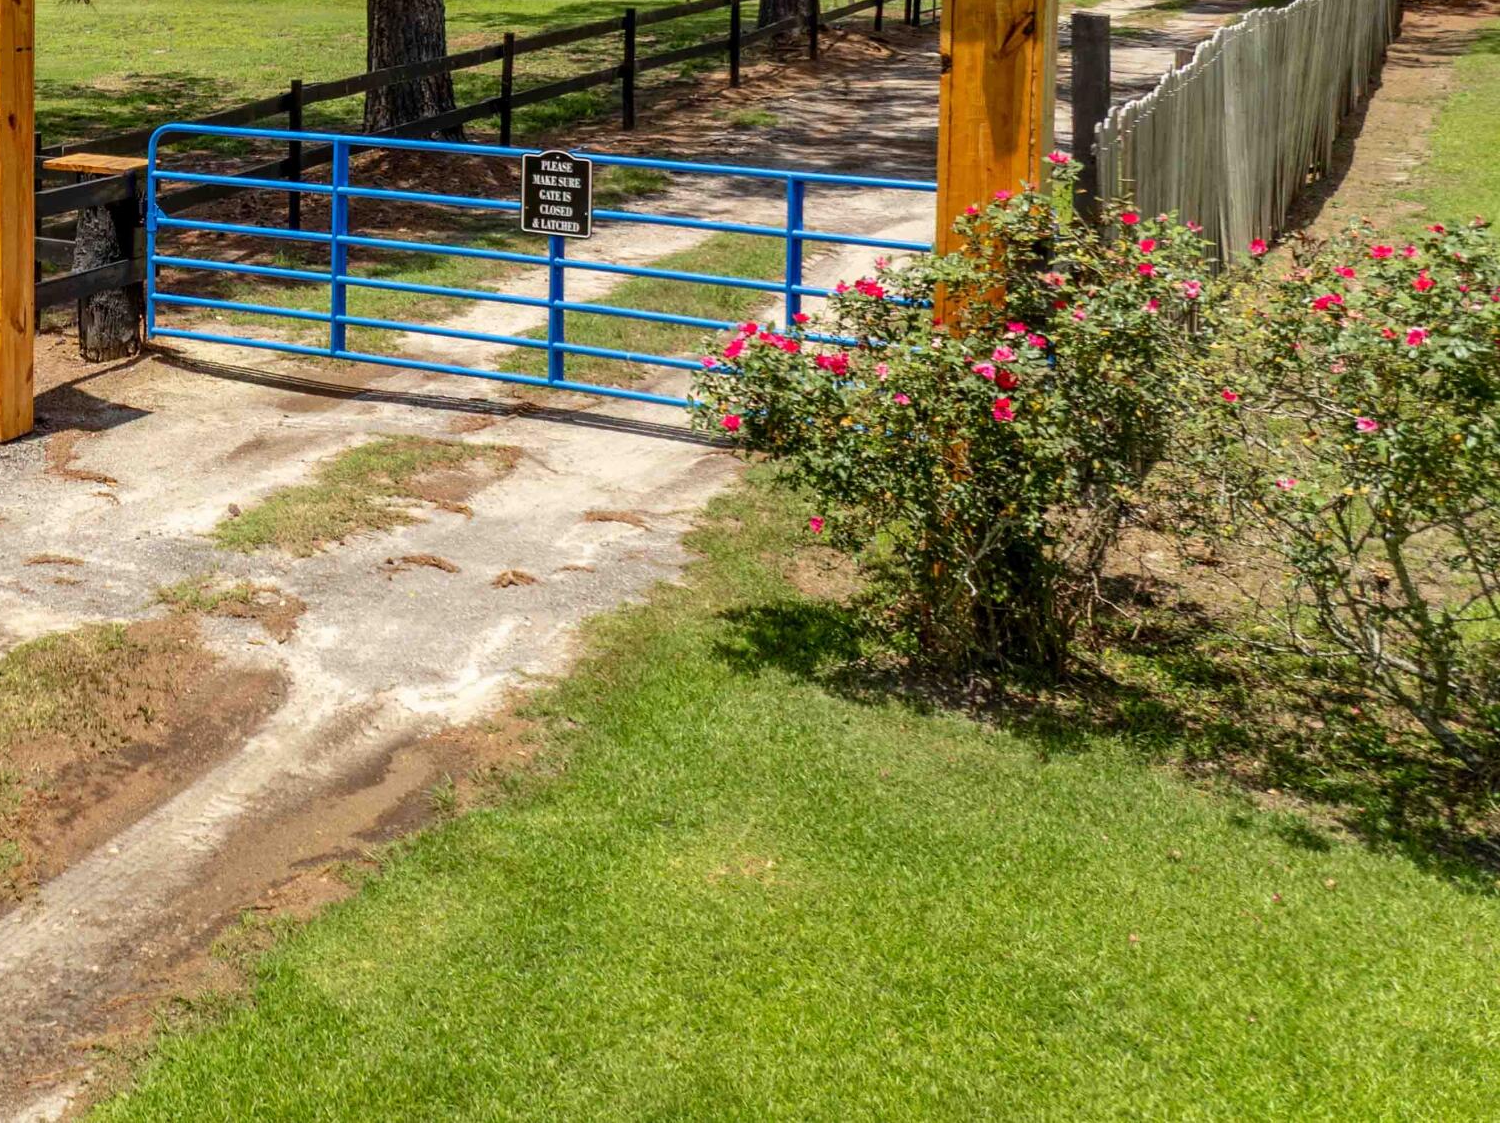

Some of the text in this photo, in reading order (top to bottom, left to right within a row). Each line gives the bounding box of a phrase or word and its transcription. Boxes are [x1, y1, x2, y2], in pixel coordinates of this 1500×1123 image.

[541, 160, 573, 173] PLEASE
[532, 174, 581, 188] MAKE SURE
[539, 189, 572, 203] GATE IS
[539, 204, 573, 217] CLOSED
[532, 217, 580, 233] & LATCHED
